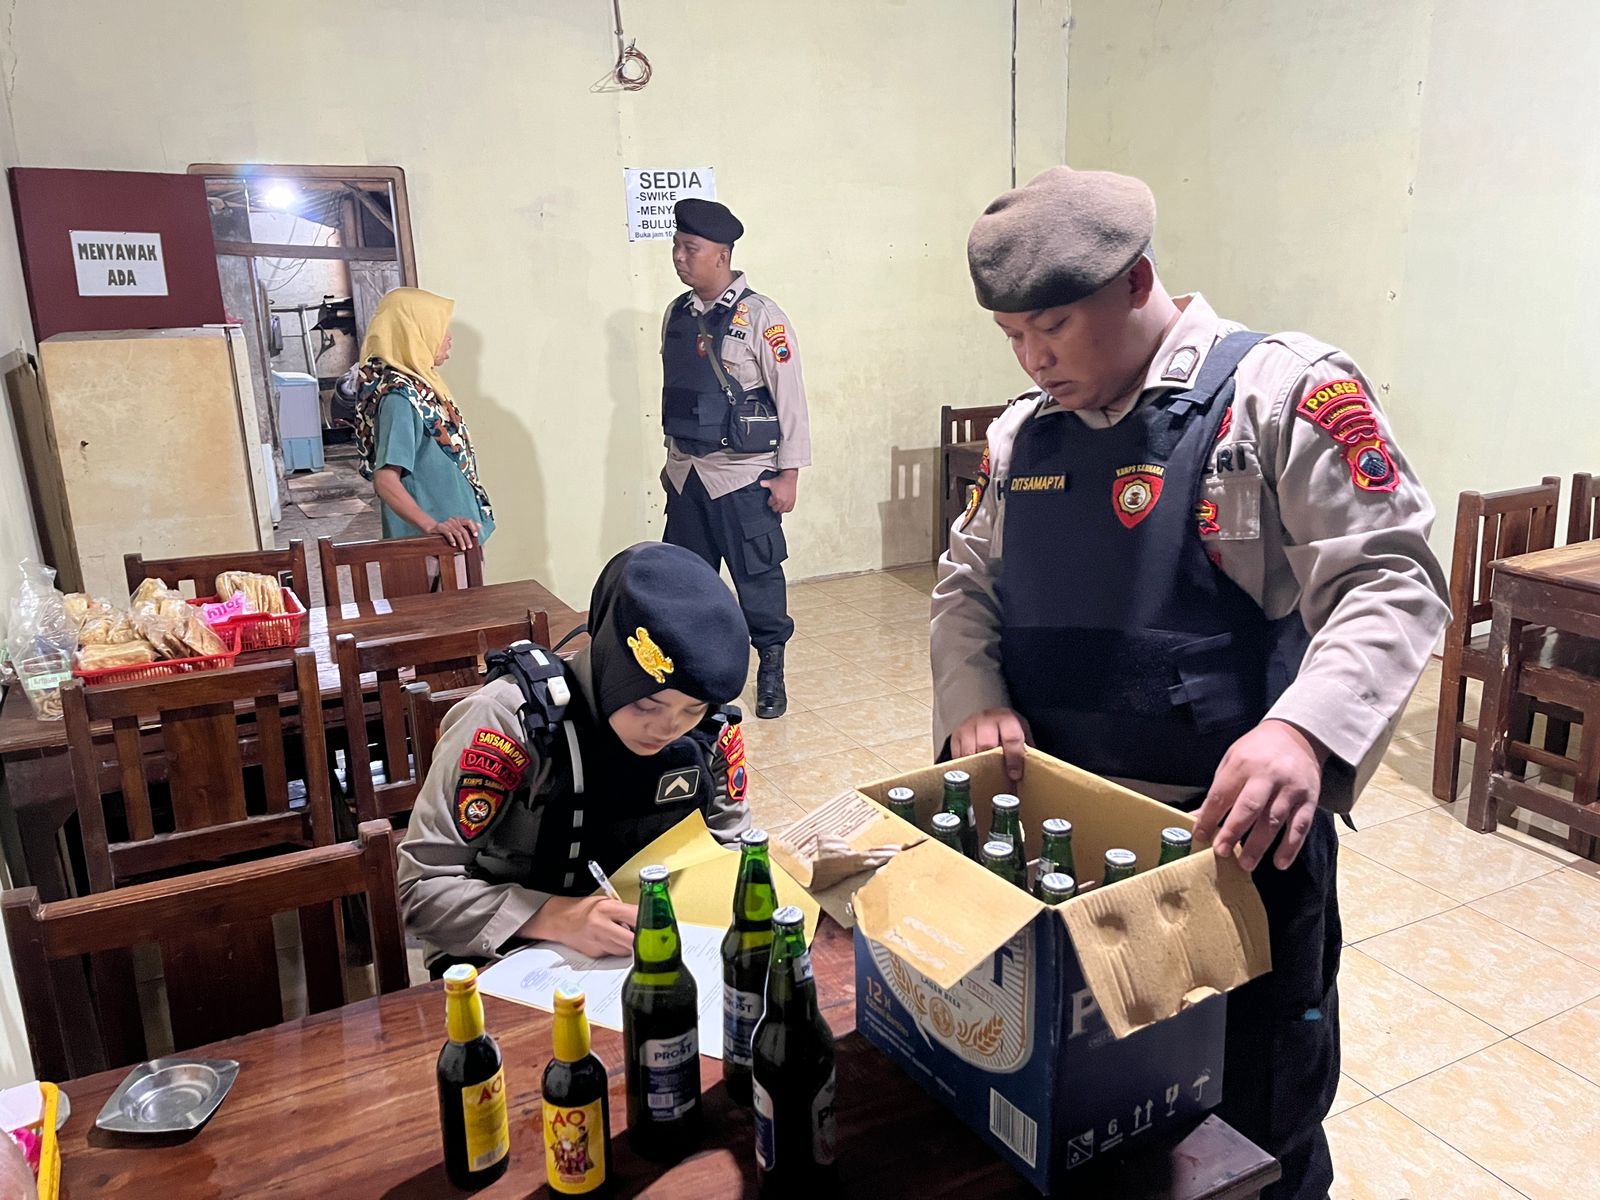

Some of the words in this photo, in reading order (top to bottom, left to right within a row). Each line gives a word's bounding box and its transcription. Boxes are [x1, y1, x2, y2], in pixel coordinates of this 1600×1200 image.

[640, 171, 702, 189] SEDIA
[636, 191, 677, 201] -SWIKE
[77, 243, 158, 261] MENYAWAK
[108, 269, 137, 286] ADA
[728, 328, 746, 340] LRI
[1305, 382, 1358, 410] POLRES
[1011, 475, 1066, 491] DITSAMAPTA
[478, 731, 526, 767] SATSAMAPTA
[654, 1043, 693, 1062] PROST
[478, 1076, 502, 1104] AO
[552, 1109, 586, 1129] AO
[1108, 1118, 1118, 1136] 6
